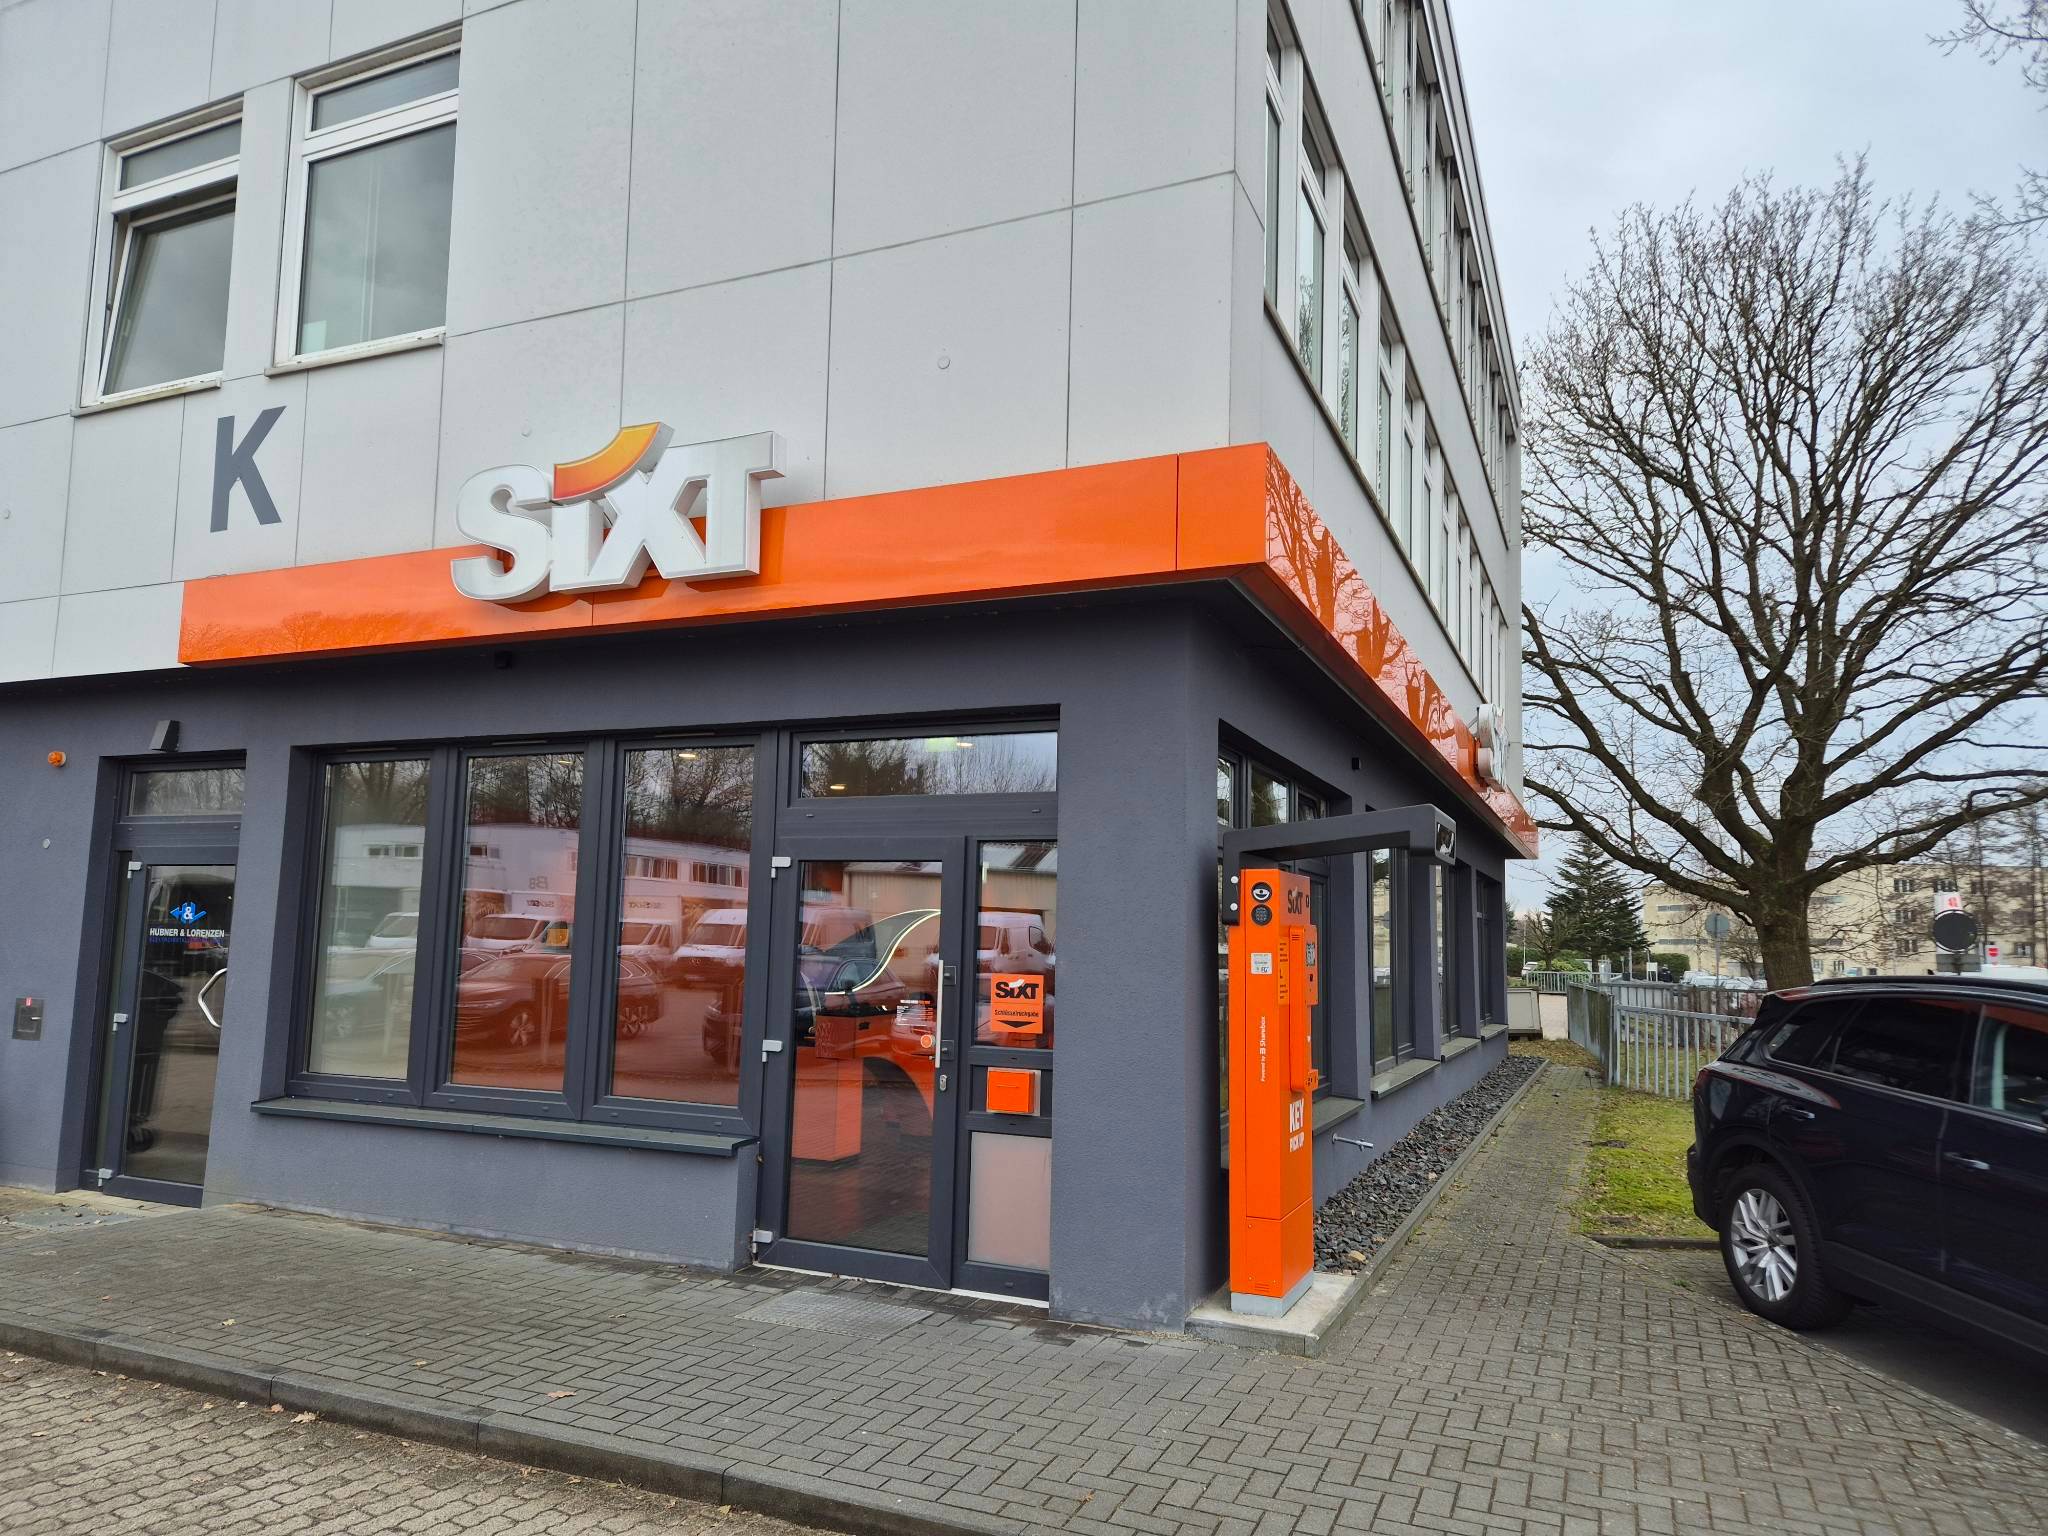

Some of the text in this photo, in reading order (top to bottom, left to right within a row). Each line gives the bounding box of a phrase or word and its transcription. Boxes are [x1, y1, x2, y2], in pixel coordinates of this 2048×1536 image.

[209, 405, 287, 533] K
[179, 928, 186, 937] &
[186, 929, 225, 938] LORENZEN
[1289, 1098, 1305, 1133] KEY
